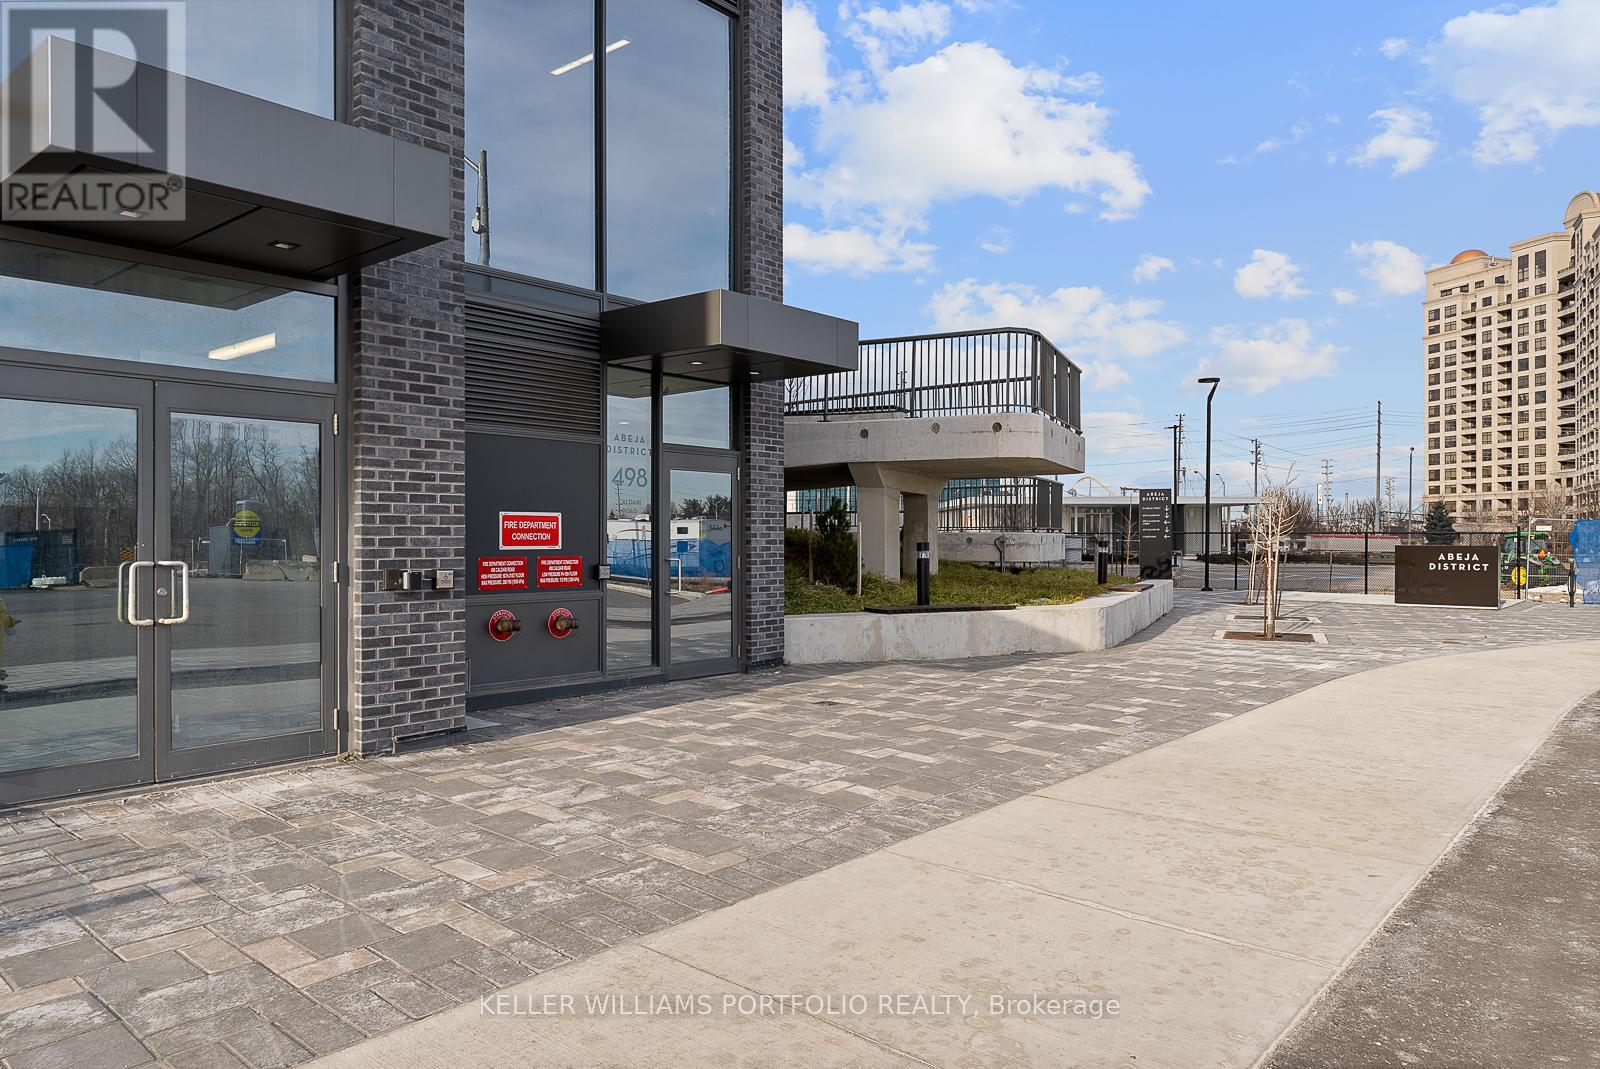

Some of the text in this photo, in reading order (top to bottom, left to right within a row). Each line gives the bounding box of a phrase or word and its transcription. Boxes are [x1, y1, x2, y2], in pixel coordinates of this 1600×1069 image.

[614, 434, 645, 443] ABEJA
[607, 445, 652, 456] DISTRICT
[611, 467, 648, 488] 498
[518, 521, 557, 530] DEPARTMENT
[511, 532, 551, 541] CONNECTION
[1438, 553, 1480, 561] ABEJA
[1429, 563, 1489, 571] DISTRICT
